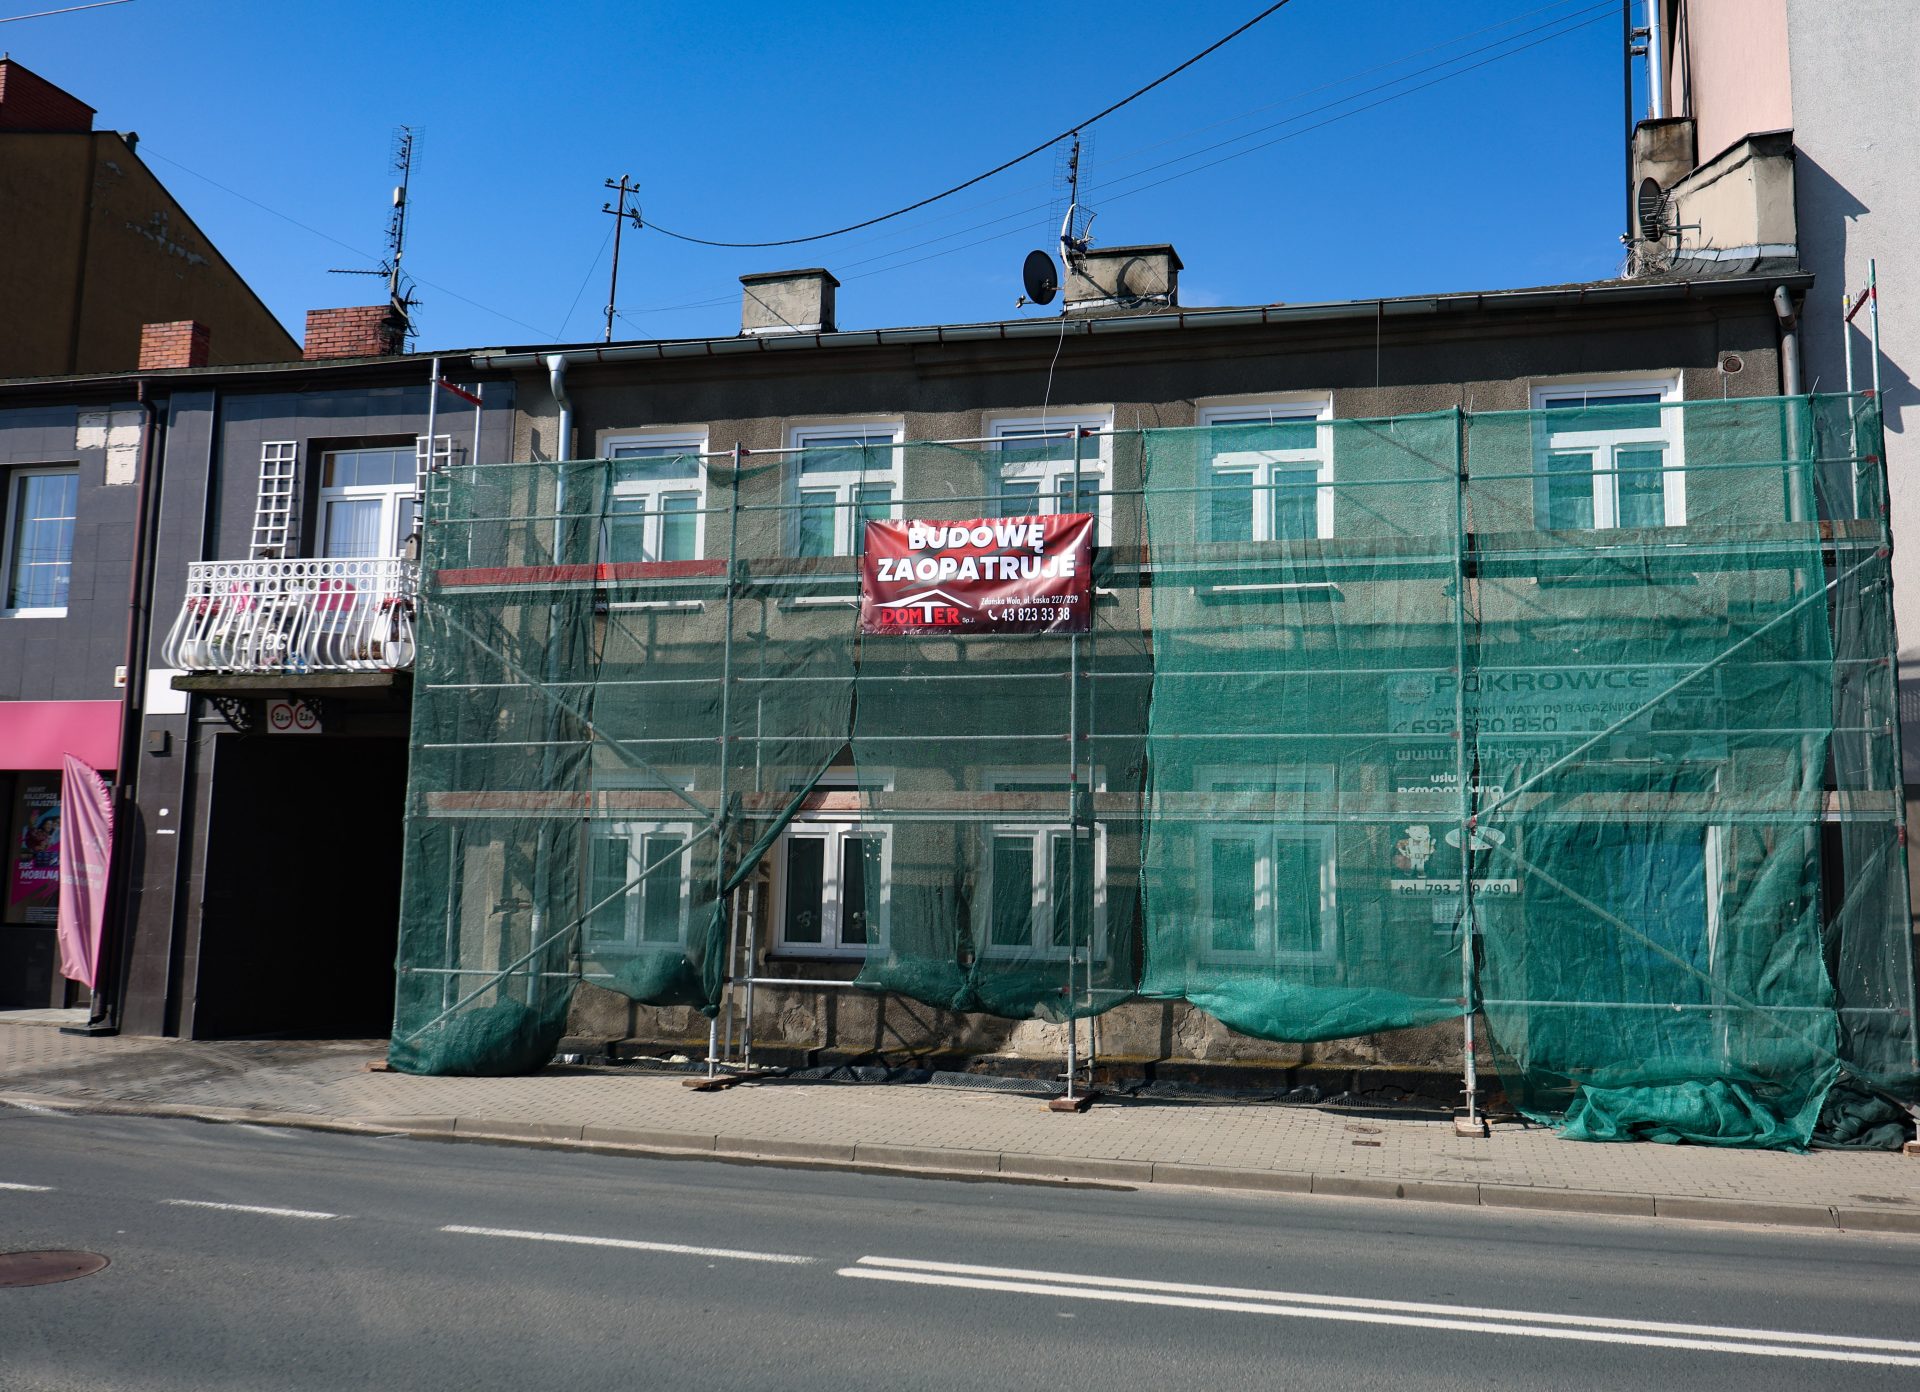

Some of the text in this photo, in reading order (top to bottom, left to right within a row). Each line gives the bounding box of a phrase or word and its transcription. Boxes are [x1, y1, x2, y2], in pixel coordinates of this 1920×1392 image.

[908, 523, 1045, 554] BUDOWĘ
[876, 553, 1076, 582] ZAOPATRUJE
[1051, 595, 1079, 604] 227/229
[881, 602, 960, 625] DOMTER
[1001, 607, 1070, 621] 43 823 33 38
[1434, 670, 1650, 694] POKROWCE
[1505, 704, 1539, 715] MATY
[1543, 703, 1562, 714] DO
[1411, 719, 1455, 734] 692
[1512, 716, 1558, 733] 850
[1395, 744, 1557, 761] www.fesh-car.pl
[1400, 883, 1511, 896] tel. 793 29 490
